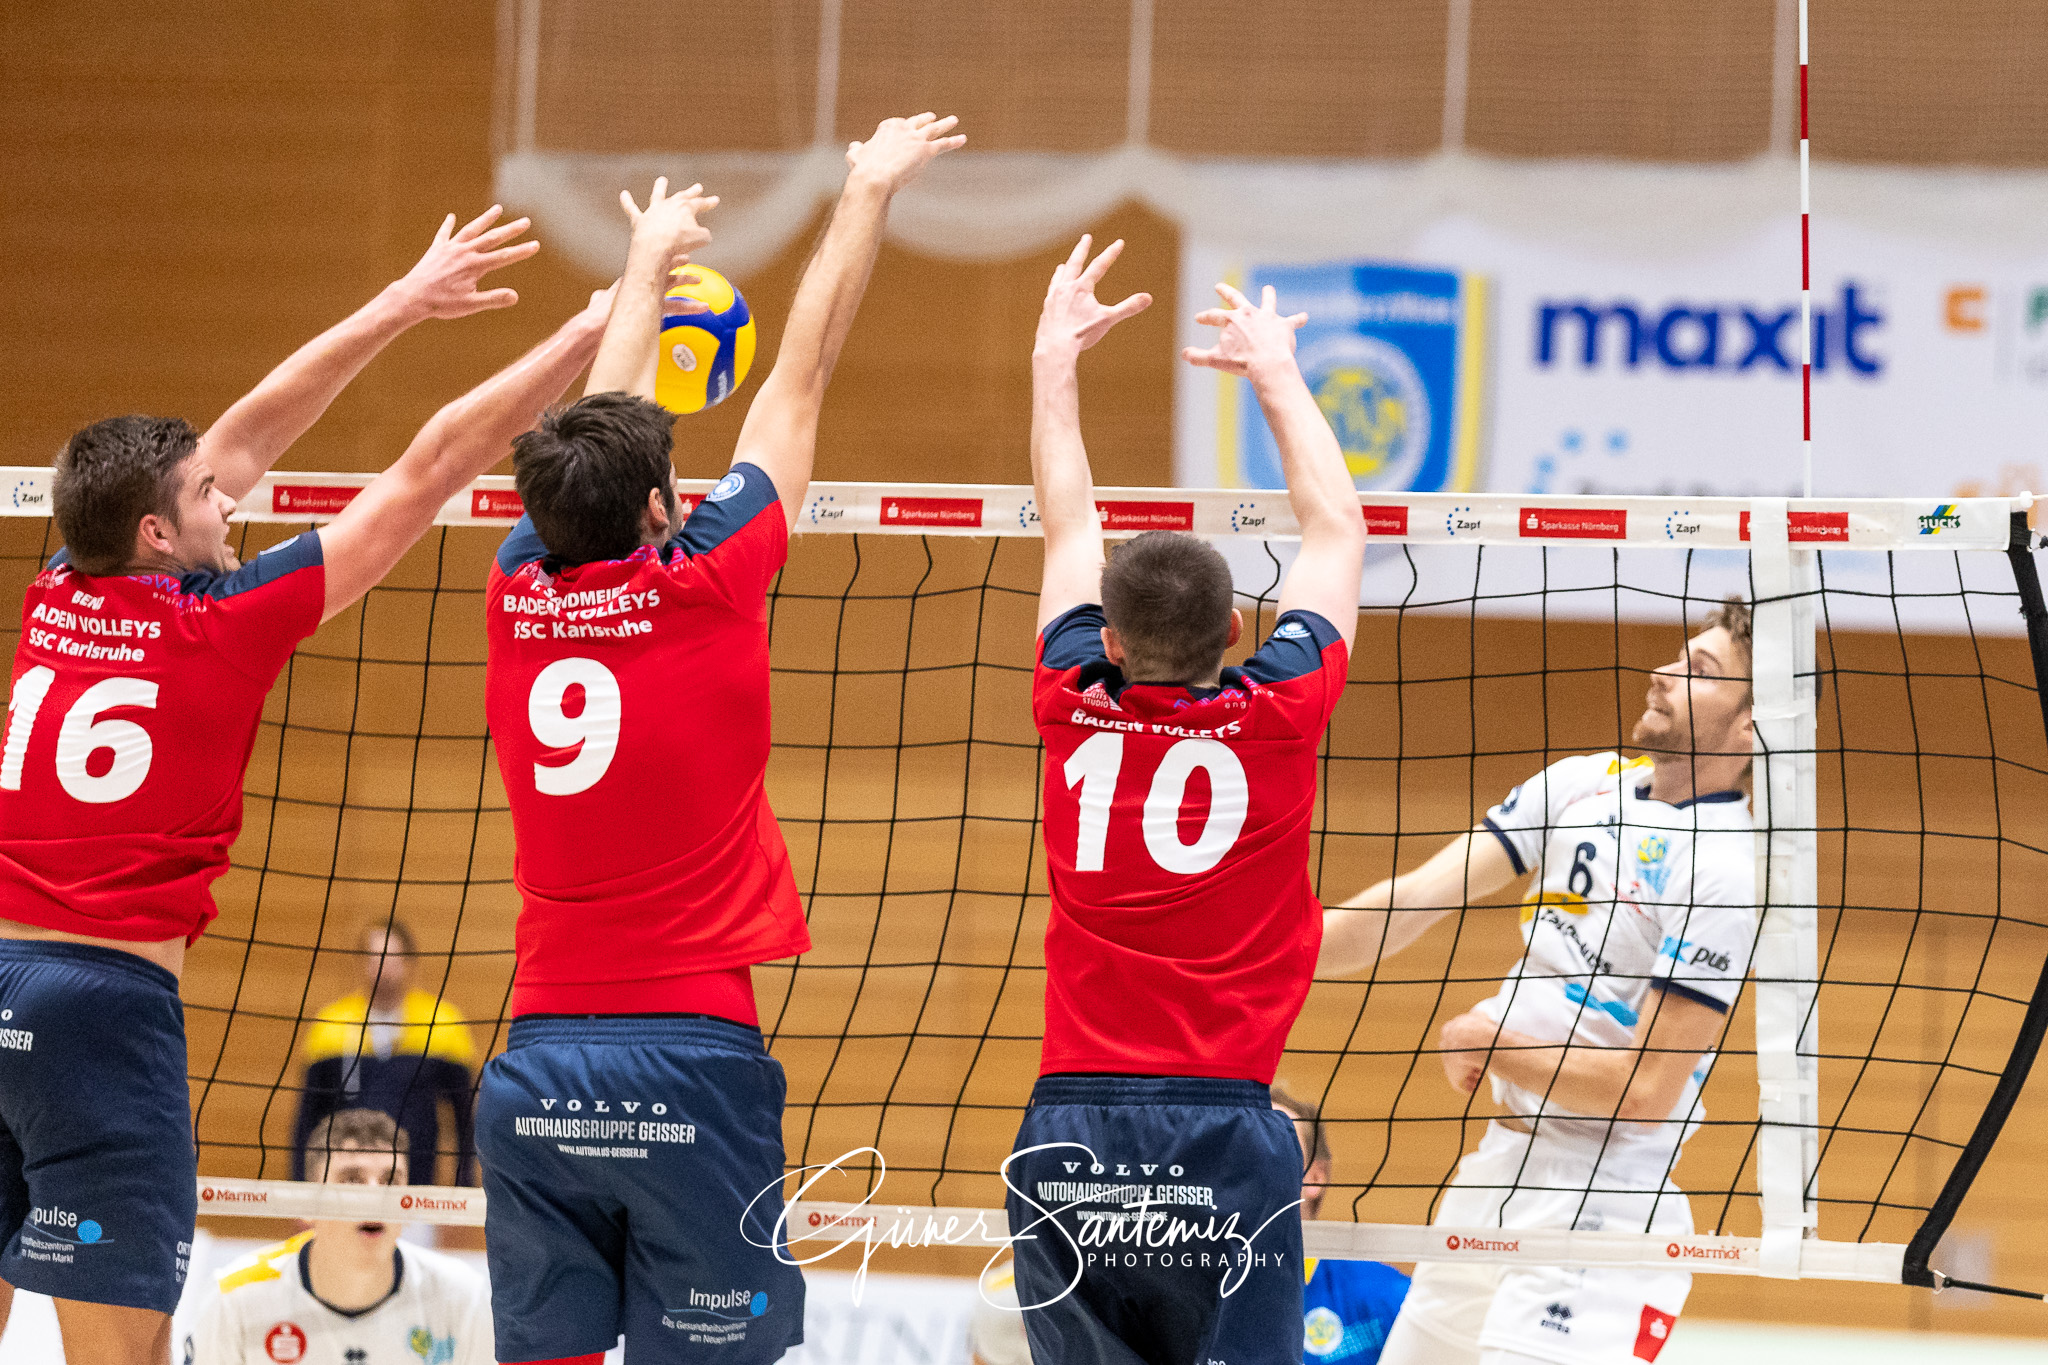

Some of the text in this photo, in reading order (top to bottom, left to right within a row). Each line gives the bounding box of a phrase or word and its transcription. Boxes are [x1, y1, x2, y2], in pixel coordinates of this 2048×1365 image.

[1536, 284, 1884, 378] maxit
[22, 494, 44, 503] Zapf
[821, 508, 844, 519] Zapf
[1241, 516, 1266, 527] Zapf
[1457, 520, 1481, 531] Zapf
[1541, 520, 1580, 531] Sparkasse
[1676, 524, 1700, 535] Zapf
[1918, 517, 1958, 529] HUCK
[79, 615, 161, 639] VOLLEYS
[514, 619, 653, 640] SSC Karlsruhe
[29, 627, 145, 662] SSC Karlsruhe
[0, 664, 160, 804] 16
[528, 657, 622, 796] 9
[1063, 731, 1250, 875] 10
[1568, 841, 1597, 897] 6
[540, 1098, 668, 1116] VOLVO
[515, 1116, 696, 1144] AUTOHAUSGRUPPE GEISSER
[1062, 1161, 1185, 1177] VOLVO
[216, 1190, 268, 1203] Marmot
[1156, 1184, 1214, 1207] GEISSER
[415, 1198, 467, 1211] Marmot
[1462, 1237, 1520, 1252] Marmot
[1683, 1245, 1740, 1260] Marmot
[689, 1287, 751, 1310] Impulse
